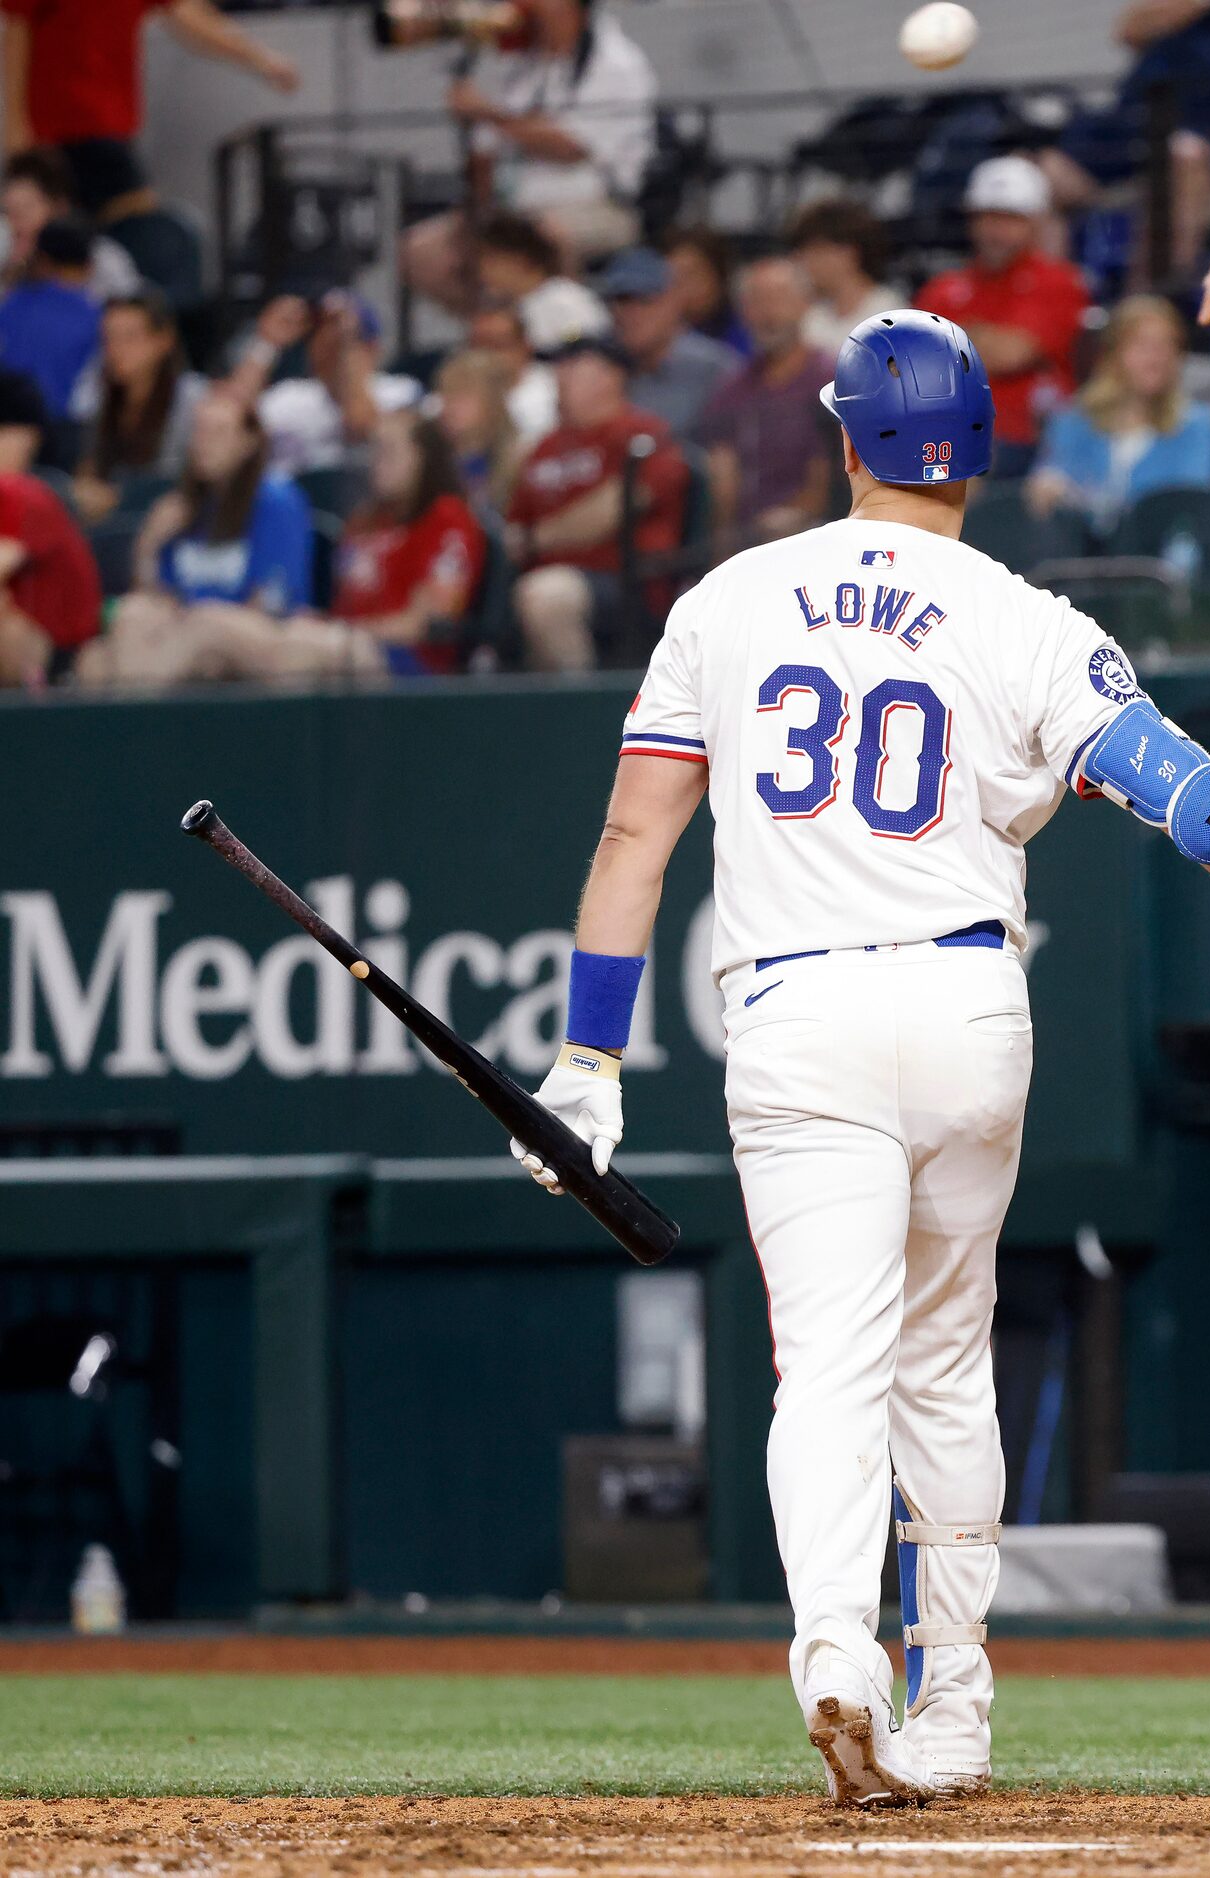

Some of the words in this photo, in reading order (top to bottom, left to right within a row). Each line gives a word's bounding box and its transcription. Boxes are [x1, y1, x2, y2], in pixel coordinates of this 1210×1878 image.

[922, 441, 952, 463] 30
[793, 582, 948, 652] LOWE
[1090, 649, 1122, 676] ENERG
[755, 664, 953, 842] 30
[1129, 735, 1149, 775] Lowe
[1157, 760, 1177, 783] 30
[572, 1057, 598, 1070] franklin
